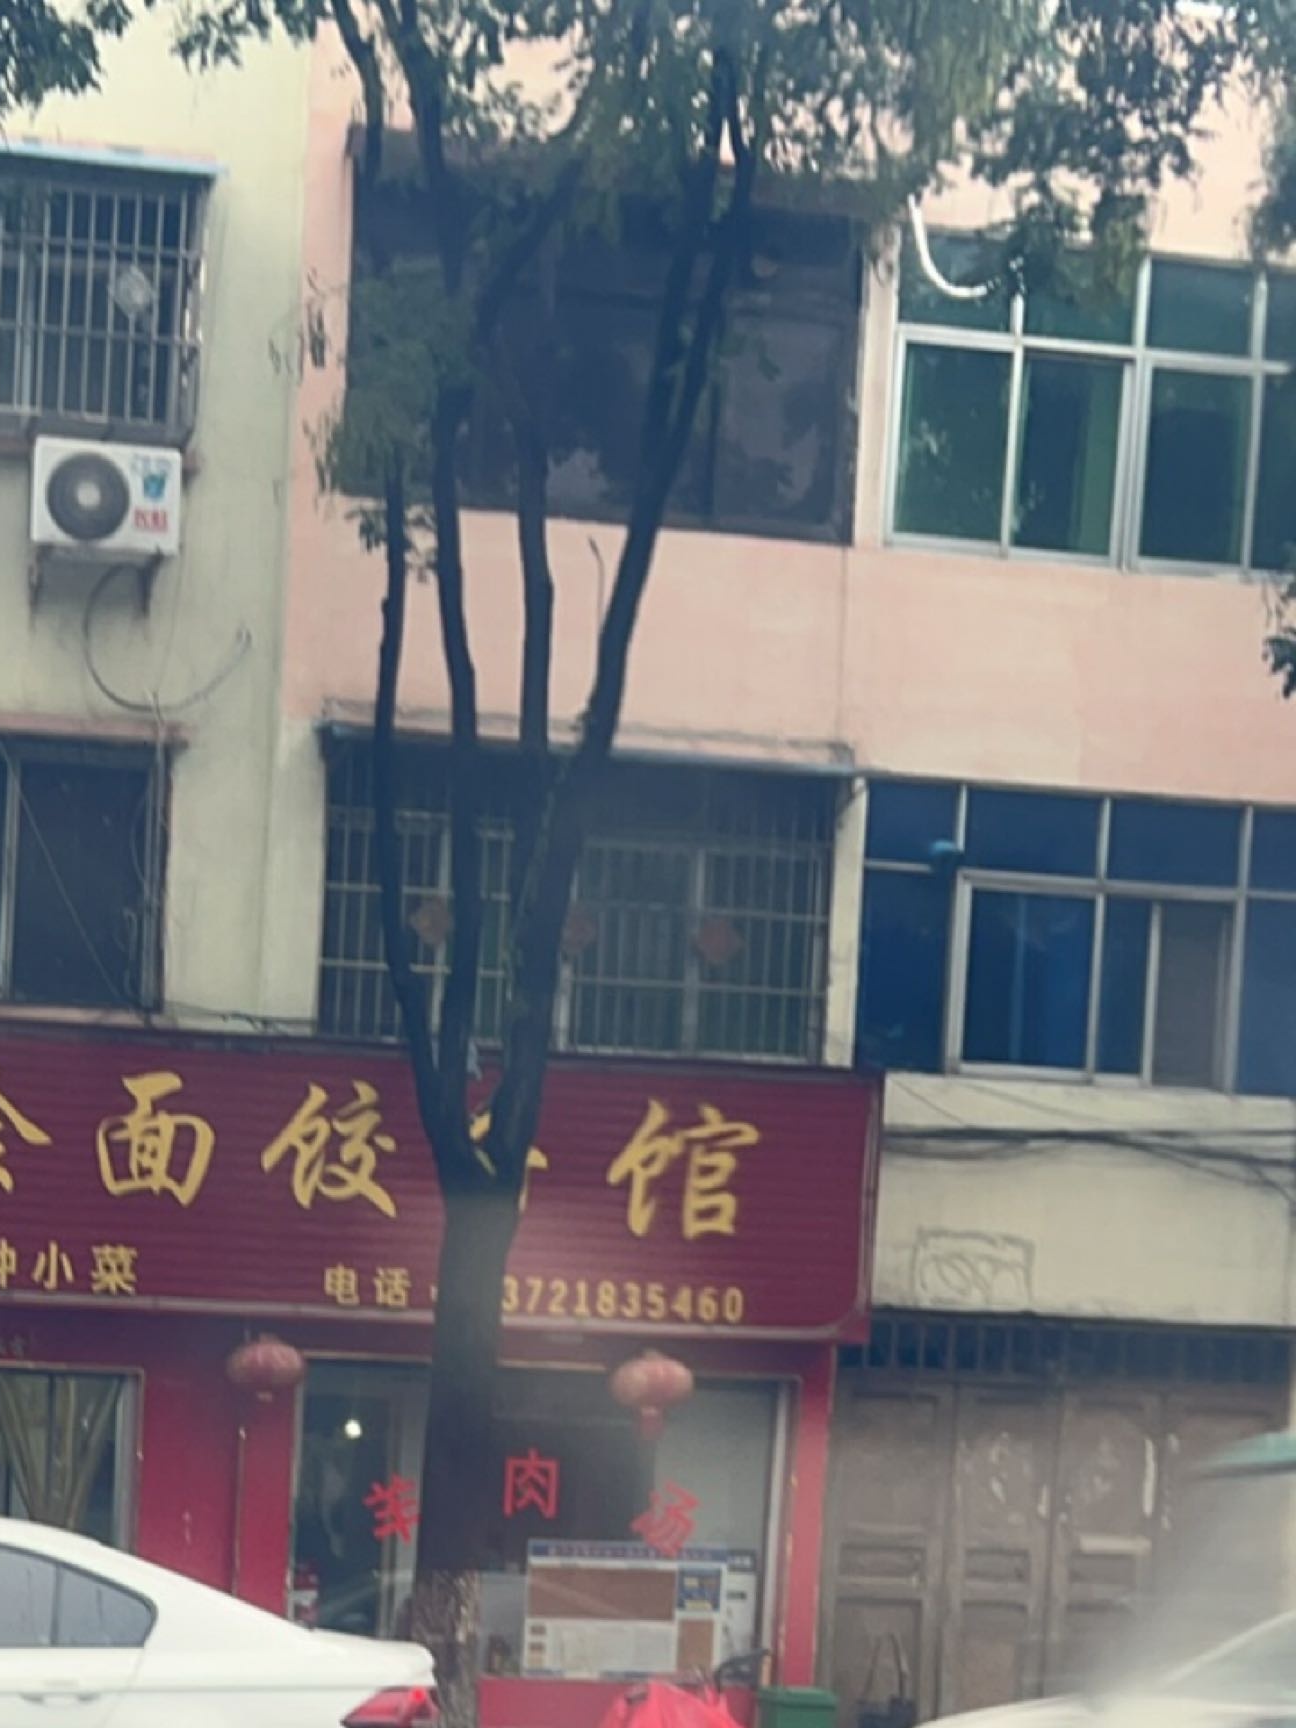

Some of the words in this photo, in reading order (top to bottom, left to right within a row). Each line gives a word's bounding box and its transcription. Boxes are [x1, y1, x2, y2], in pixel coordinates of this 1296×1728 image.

[324, 1263, 412, 1308] 电话
[501, 1274, 745, 1324] 3721835460
[363, 1446, 701, 1558] 羊肉汤
